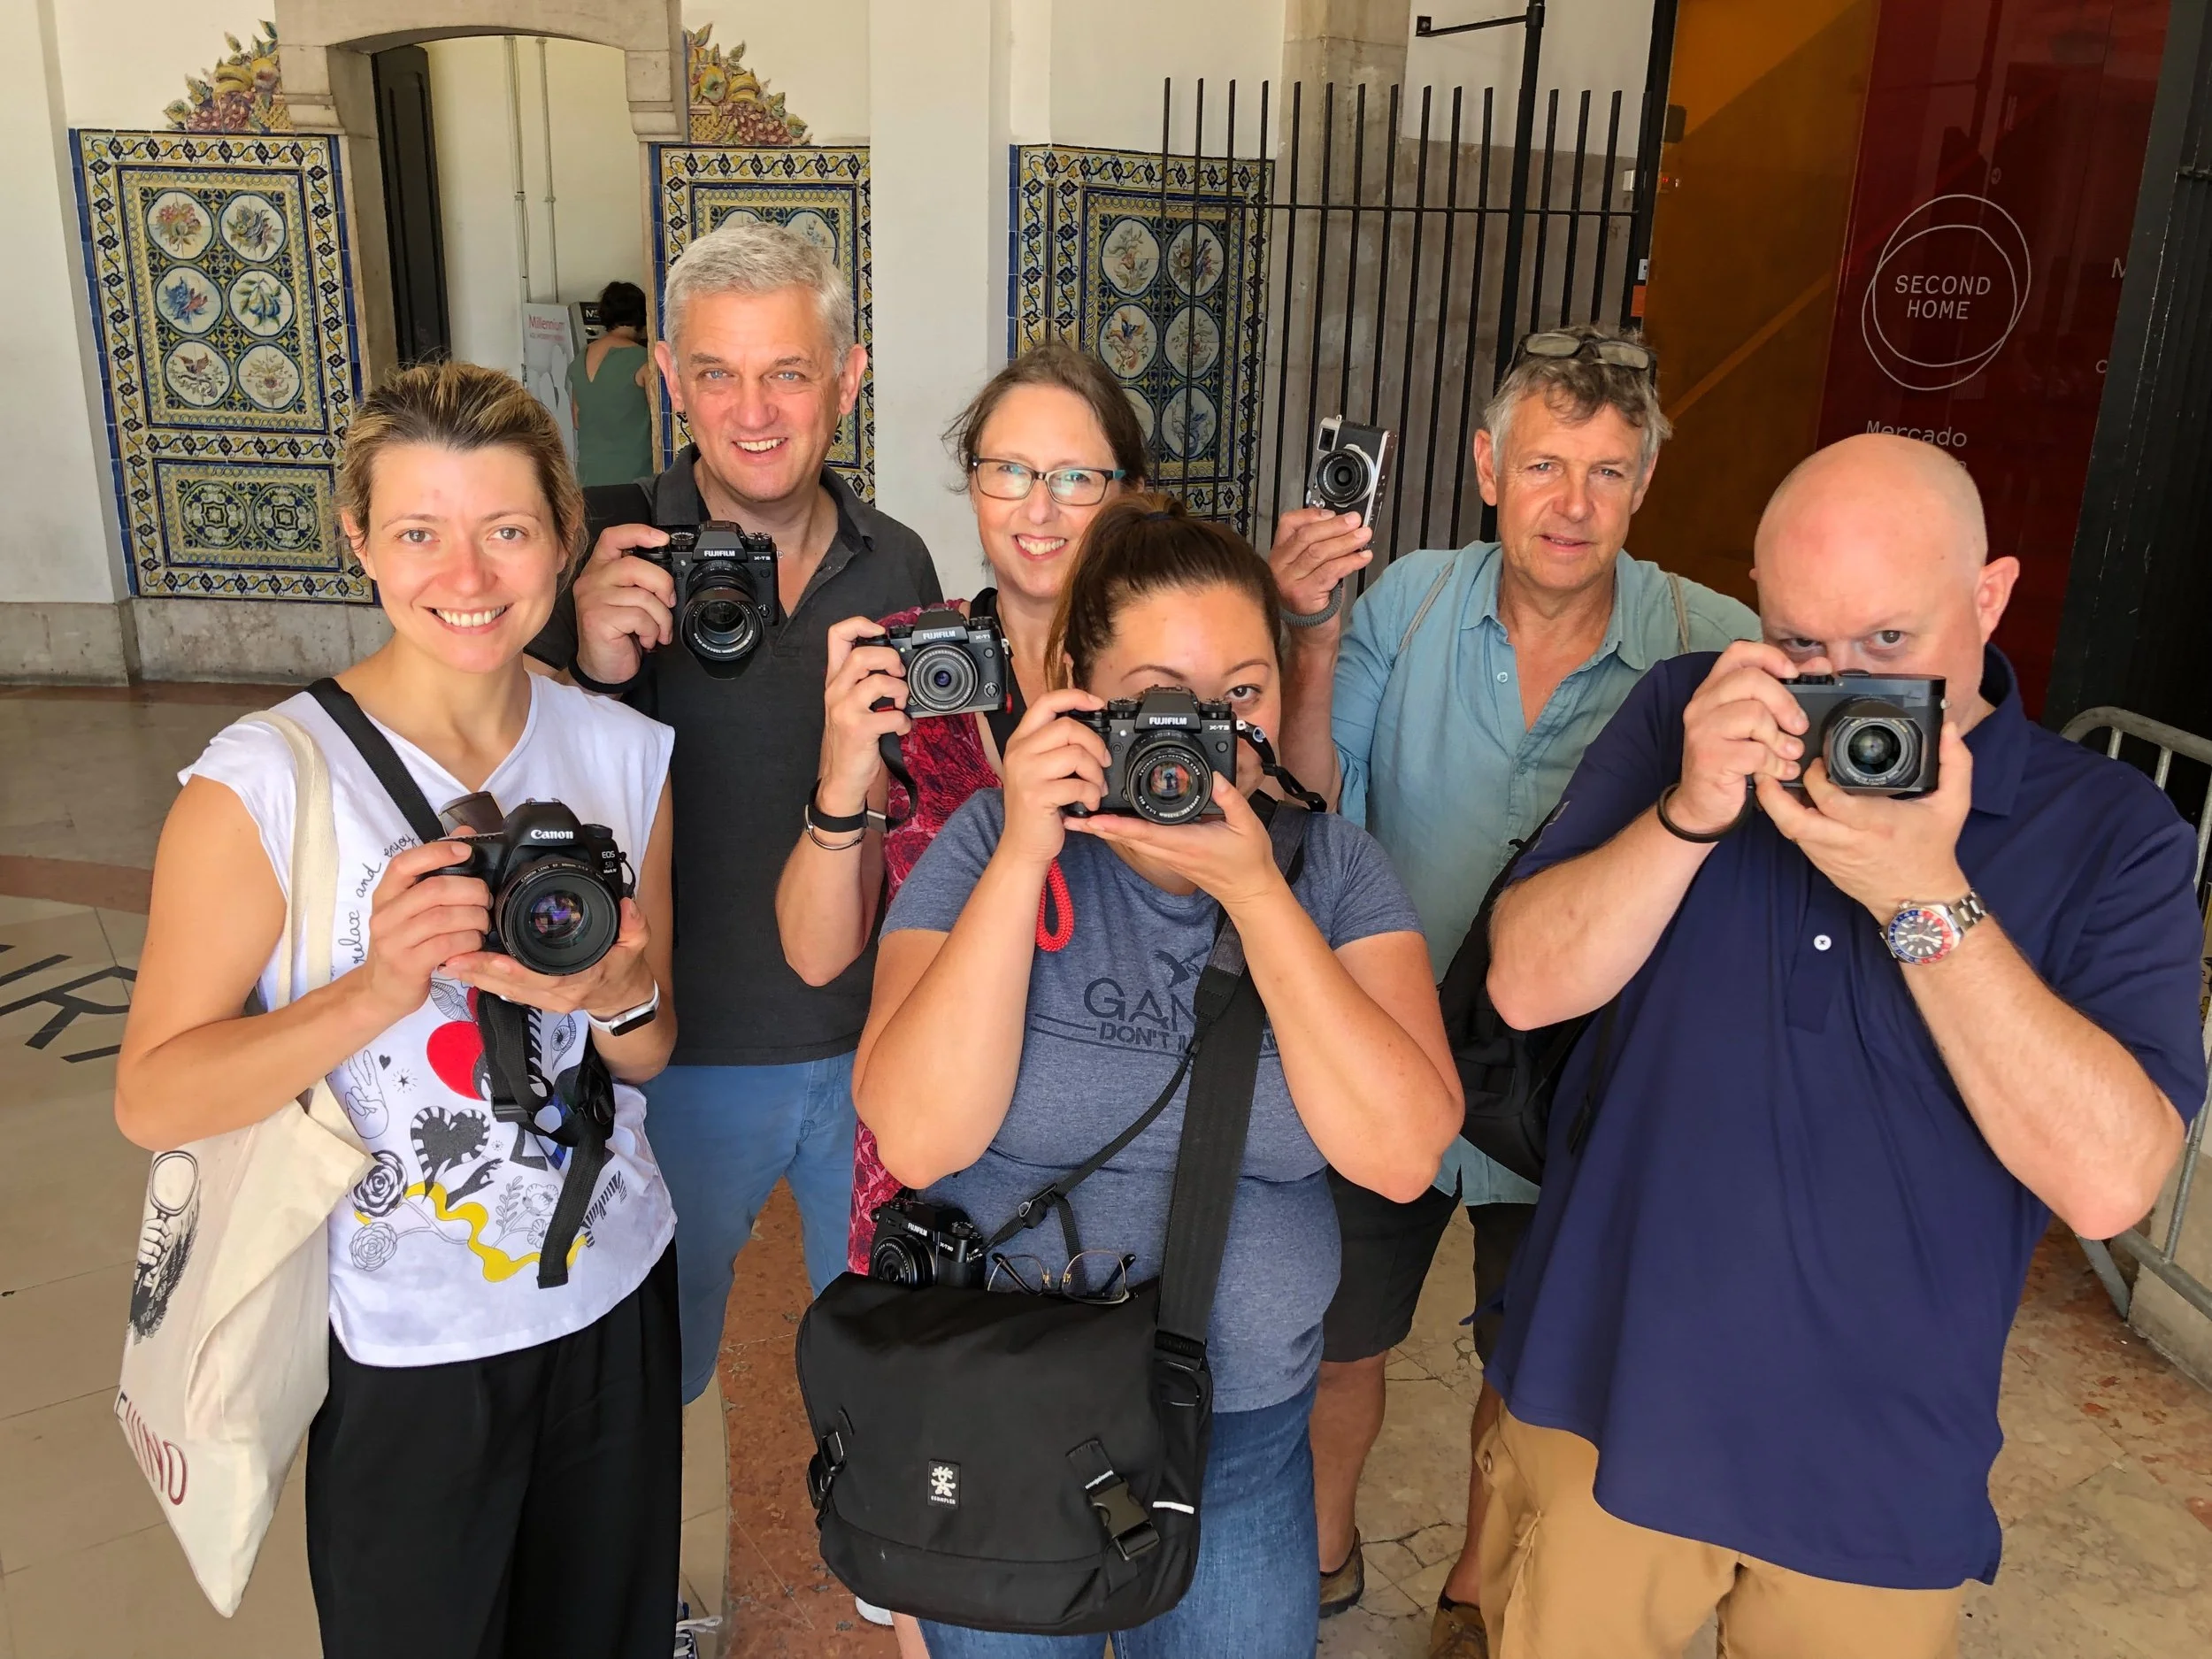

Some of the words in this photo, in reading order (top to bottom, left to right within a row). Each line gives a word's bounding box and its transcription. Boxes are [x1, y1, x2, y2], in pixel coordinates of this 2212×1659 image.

[1894, 275, 1991, 296] SECOND
[1907, 300, 1970, 319] HOME
[923, 630, 956, 640] FUJIFILM
[1149, 717, 1187, 726] FUJIFILM
[531, 829, 574, 841] Canon
[602, 850, 616, 859] EOS
[338, 910, 365, 964] relax
[356, 862, 381, 898] and
[1099, 1022, 1171, 1049] DON'T
[907, 1222, 928, 1237] FUJIFILM
